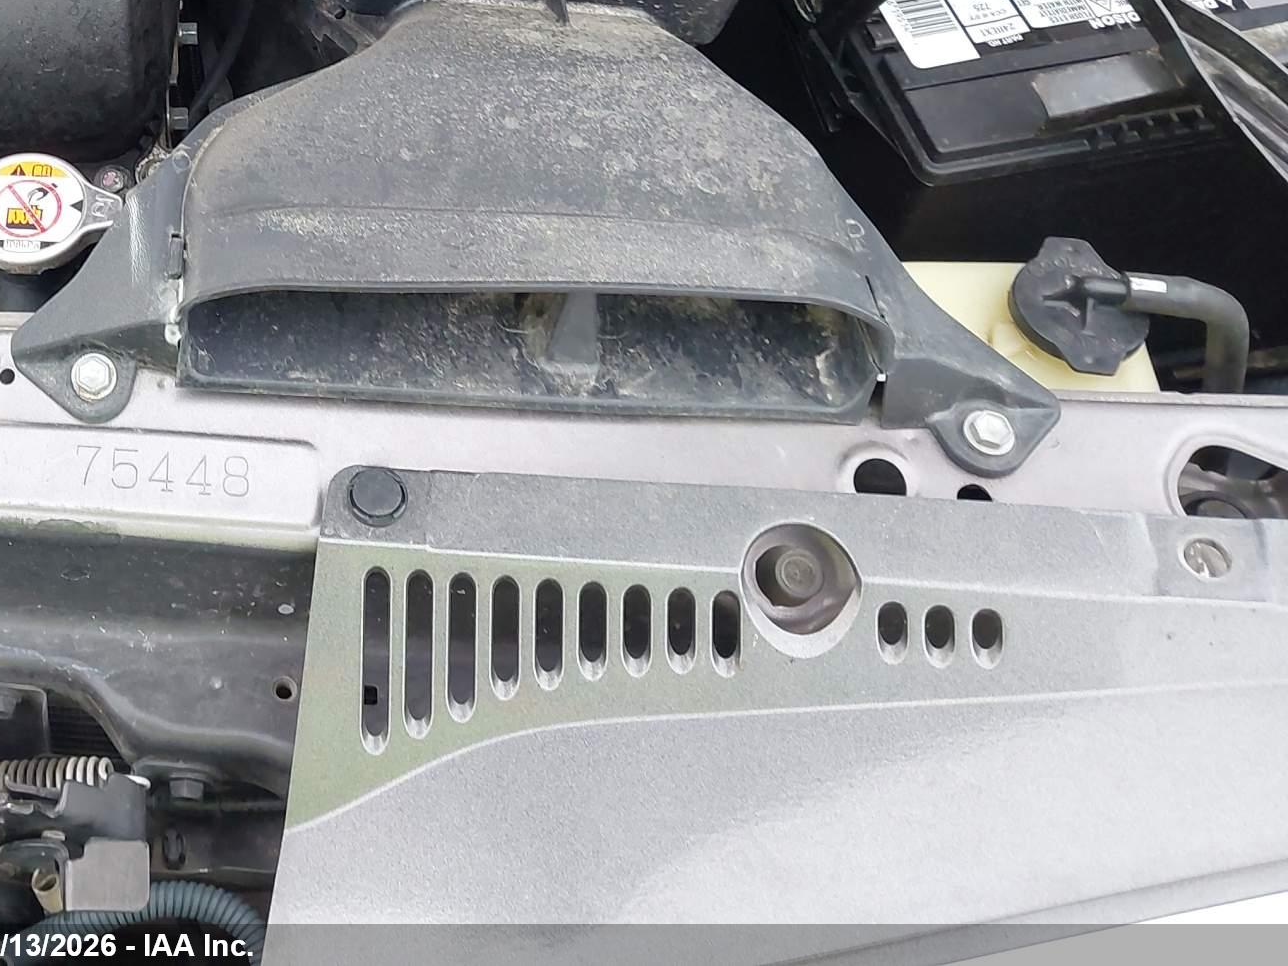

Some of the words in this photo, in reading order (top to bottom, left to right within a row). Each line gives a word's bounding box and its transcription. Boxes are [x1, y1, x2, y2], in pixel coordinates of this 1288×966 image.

[973, 3, 991, 12] 725
[1002, 33, 1024, 44] PART
[75, 444, 250, 498] 75448
